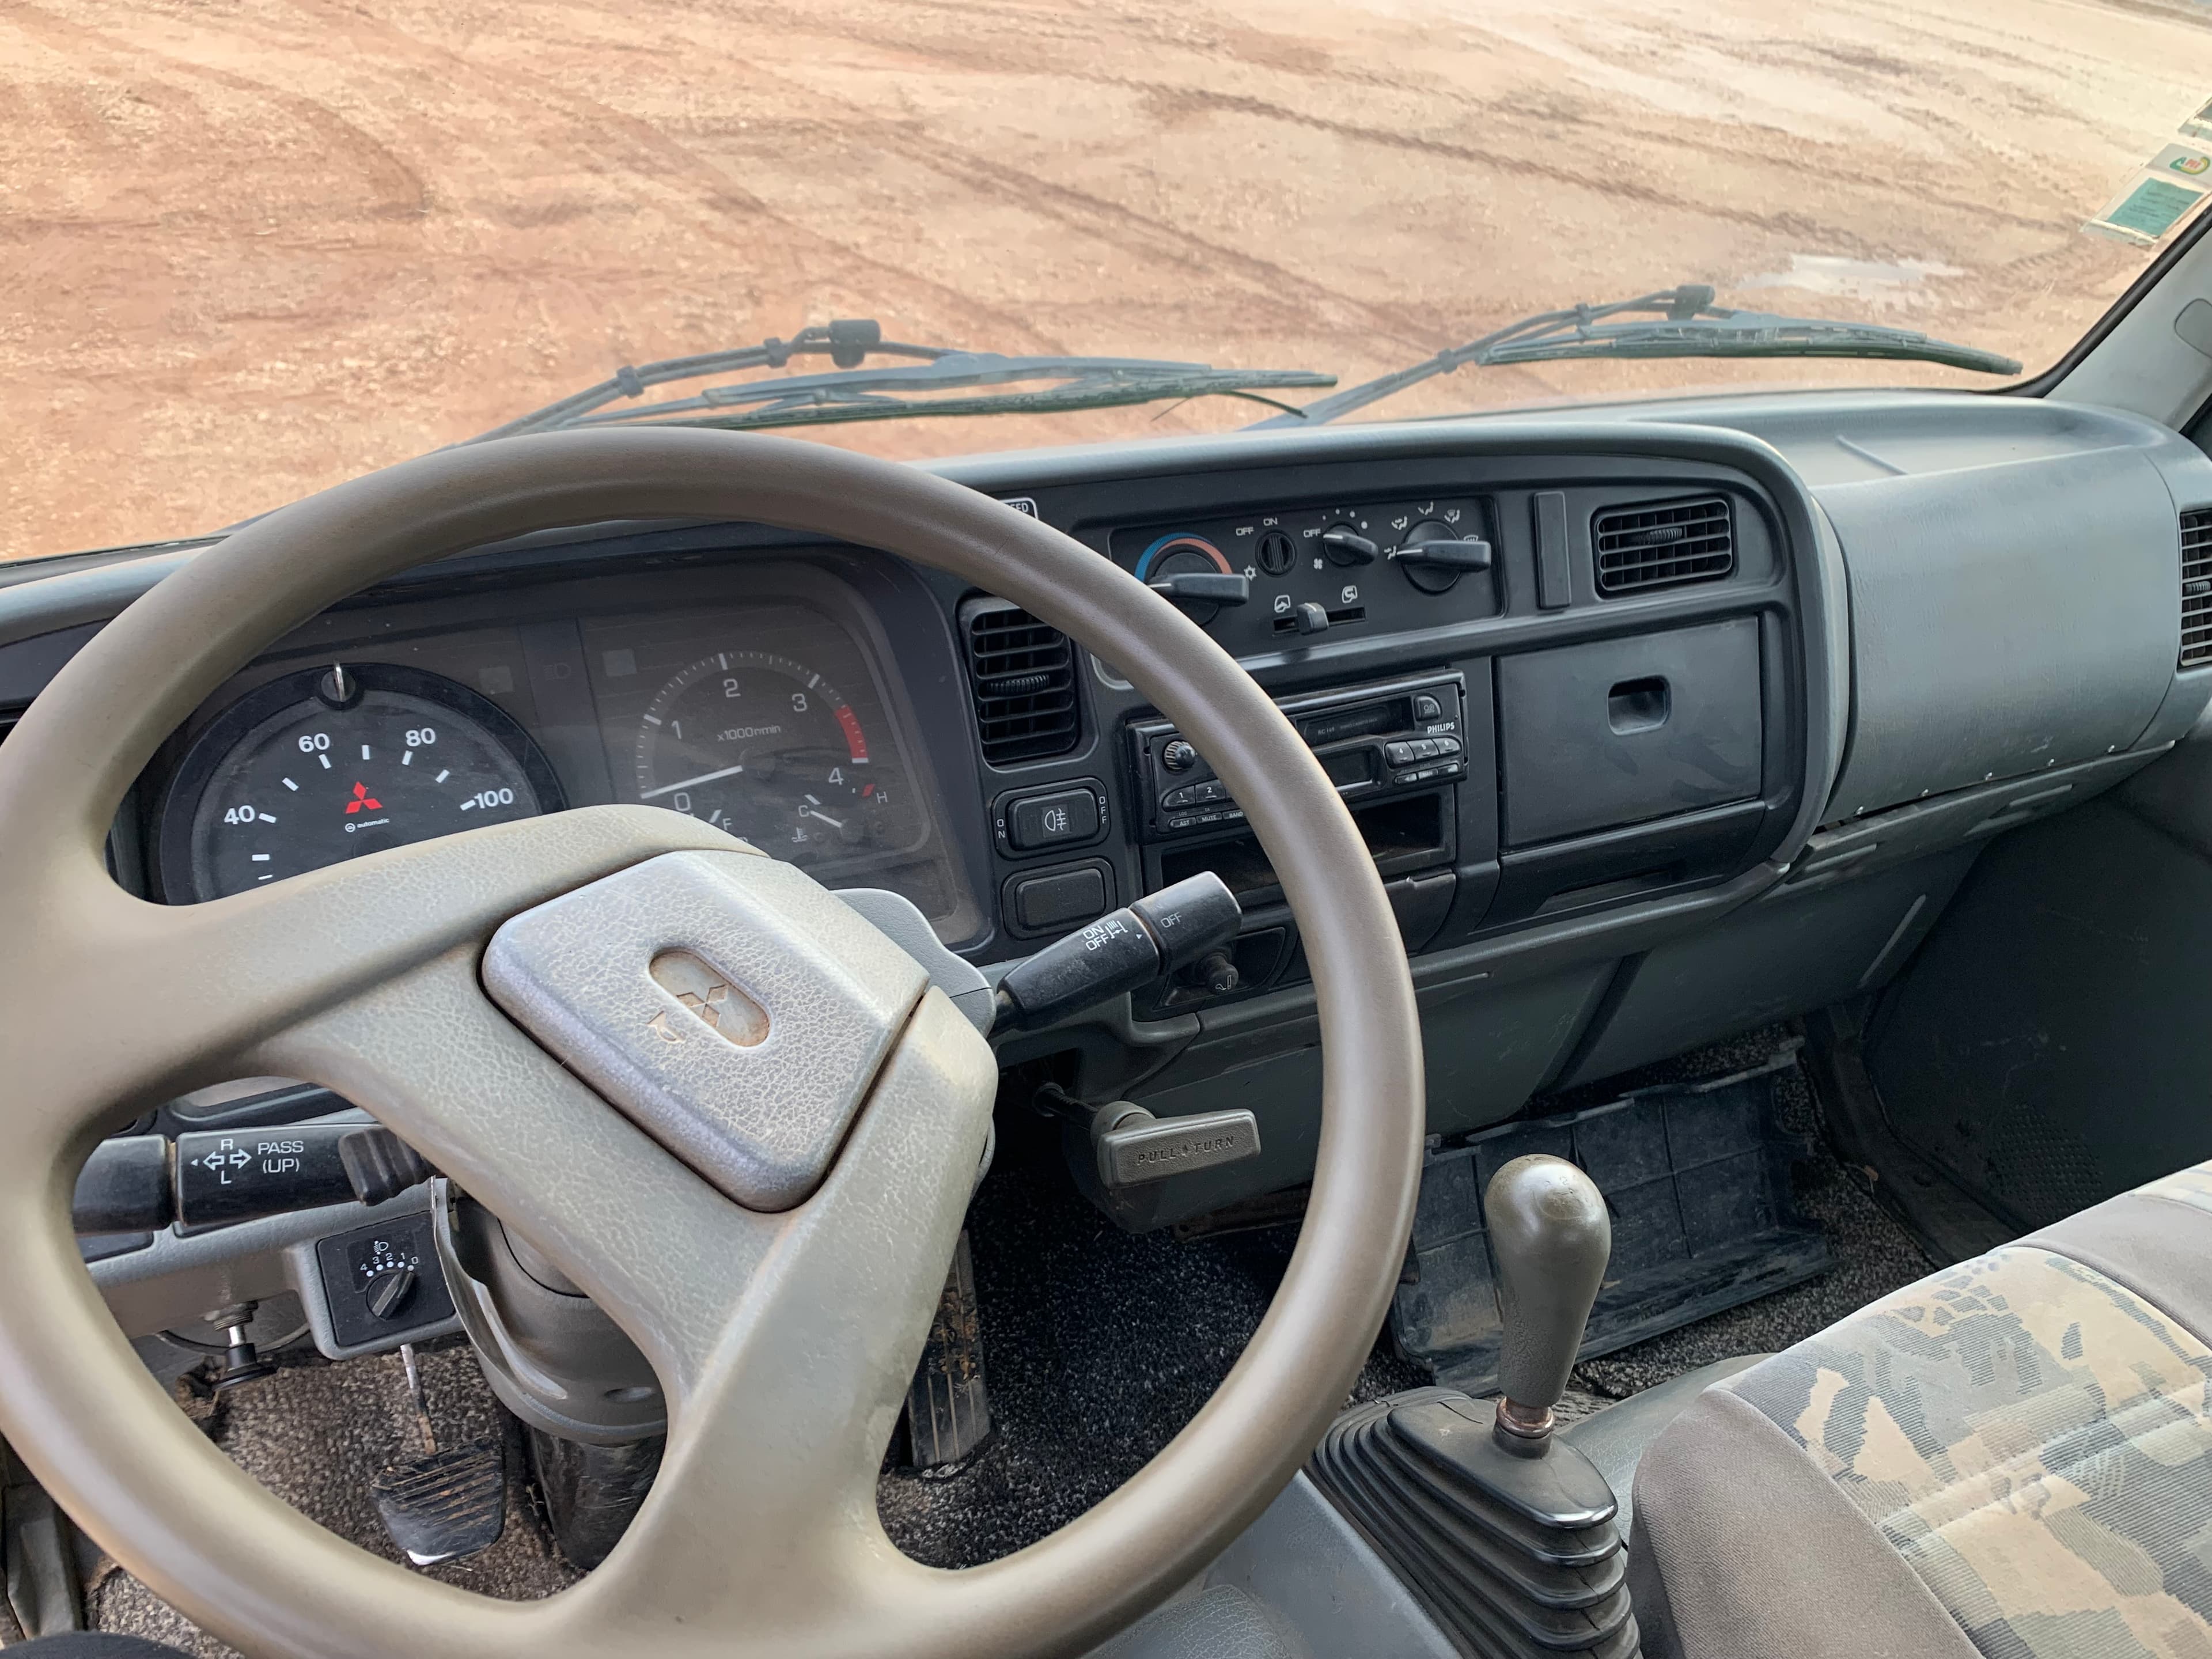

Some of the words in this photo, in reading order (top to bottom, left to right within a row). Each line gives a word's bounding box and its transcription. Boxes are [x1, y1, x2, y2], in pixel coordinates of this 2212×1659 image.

[1236, 527, 1254, 536] OFF
[1304, 528, 1321, 538] OFF
[723, 679, 741, 698] 2
[791, 694, 808, 713] 3
[671, 720, 681, 740] 1
[1427, 721, 1455, 734] PHILIPS
[298, 732, 331, 752] 60
[405, 727, 436, 747] 80
[828, 767, 844, 785] 4
[474, 787, 513, 808] 100
[673, 791, 691, 812] 0
[876, 790, 888, 804] H
[224, 804, 255, 825] 40
[798, 804, 809, 818] C
[357, 818, 389, 828] automatic
[722, 817, 733, 830] F
[1160, 912, 1183, 930] OFF
[1082, 926, 1104, 940] ON
[1085, 935, 1108, 951] OFF
[221, 1139, 233, 1151] R
[257, 1140, 304, 1154] PASS
[1137, 1147, 1176, 1165] PULL
[1193, 1135, 1234, 1154] TURN
[262, 1158, 300, 1174] (UP)
[221, 1171, 232, 1184] L
[359, 1263, 368, 1271] 4
[373, 1256, 380, 1264] 3
[385, 1252, 393, 1260] 2
